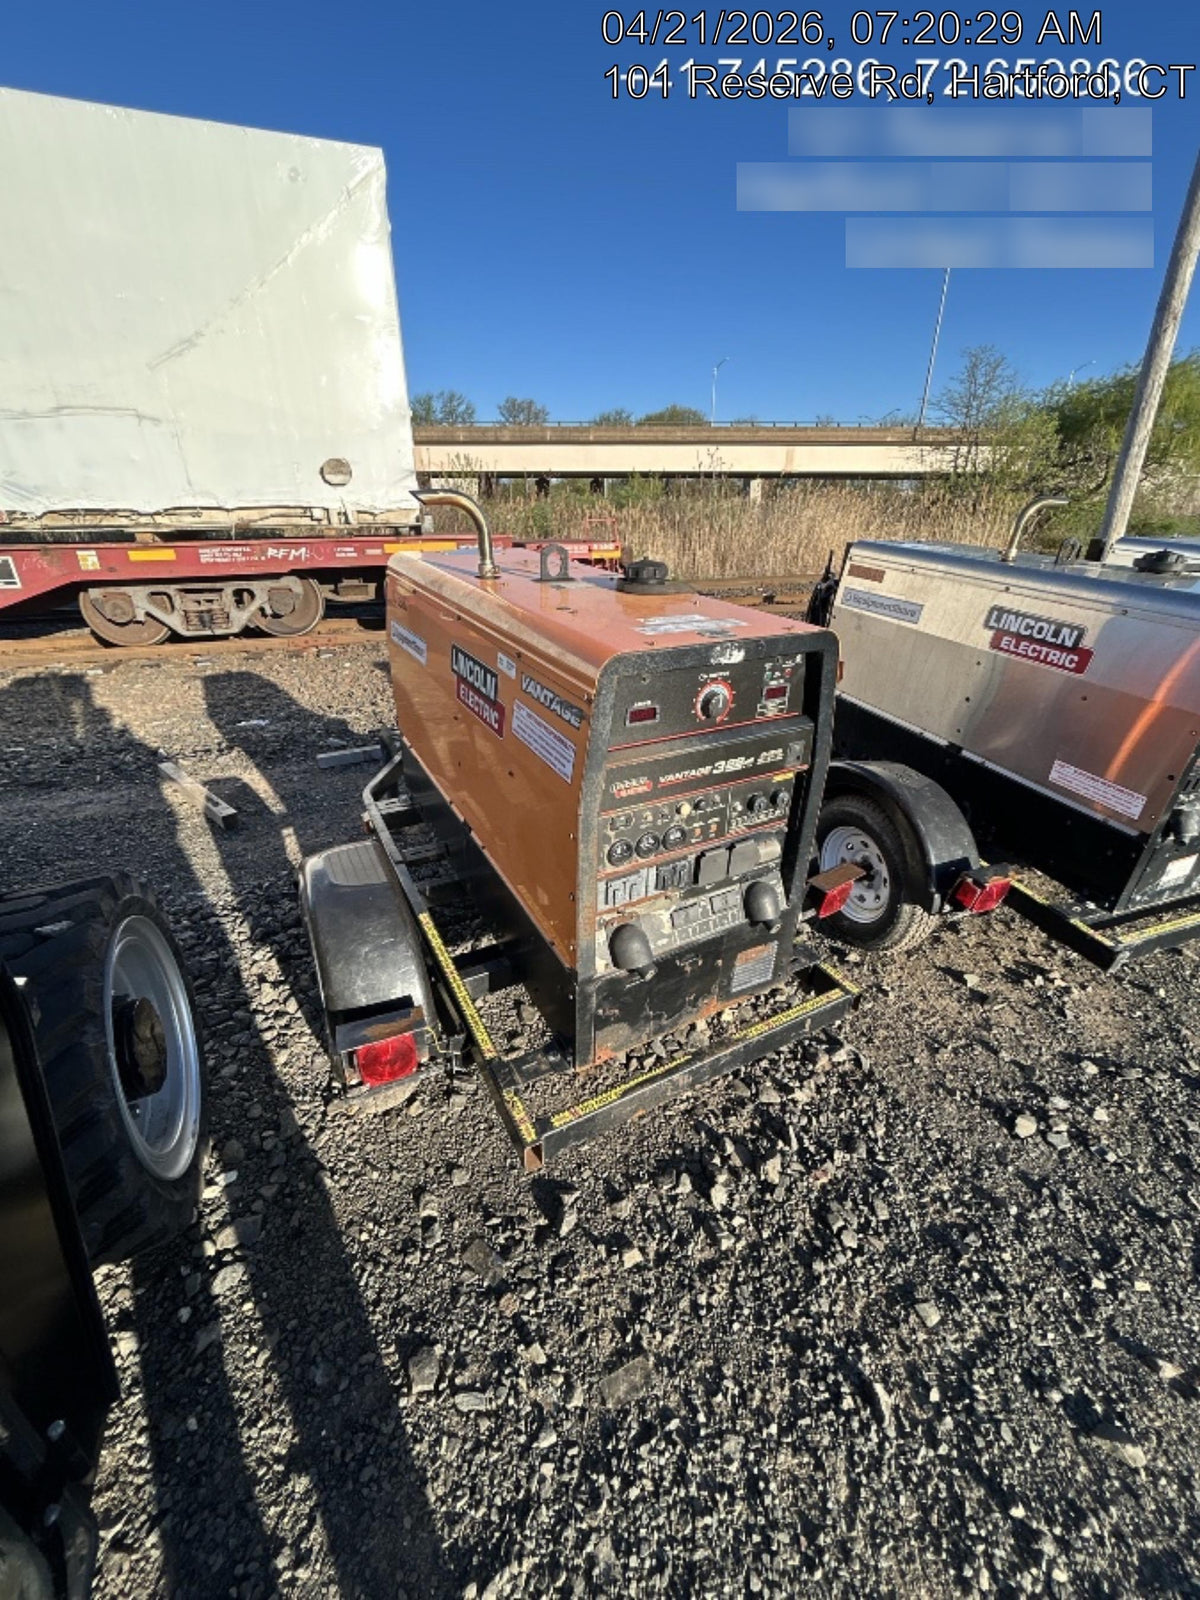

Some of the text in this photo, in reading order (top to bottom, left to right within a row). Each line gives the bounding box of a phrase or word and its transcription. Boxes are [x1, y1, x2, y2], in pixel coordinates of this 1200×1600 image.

[988, 609, 1079, 648] LINCOLN
[451, 648, 497, 701] LINCOLN
[999, 636, 1080, 669] ELECTRIC
[459, 684, 500, 730] ELECTRIC
[521, 673, 582, 729] VANTAGE
